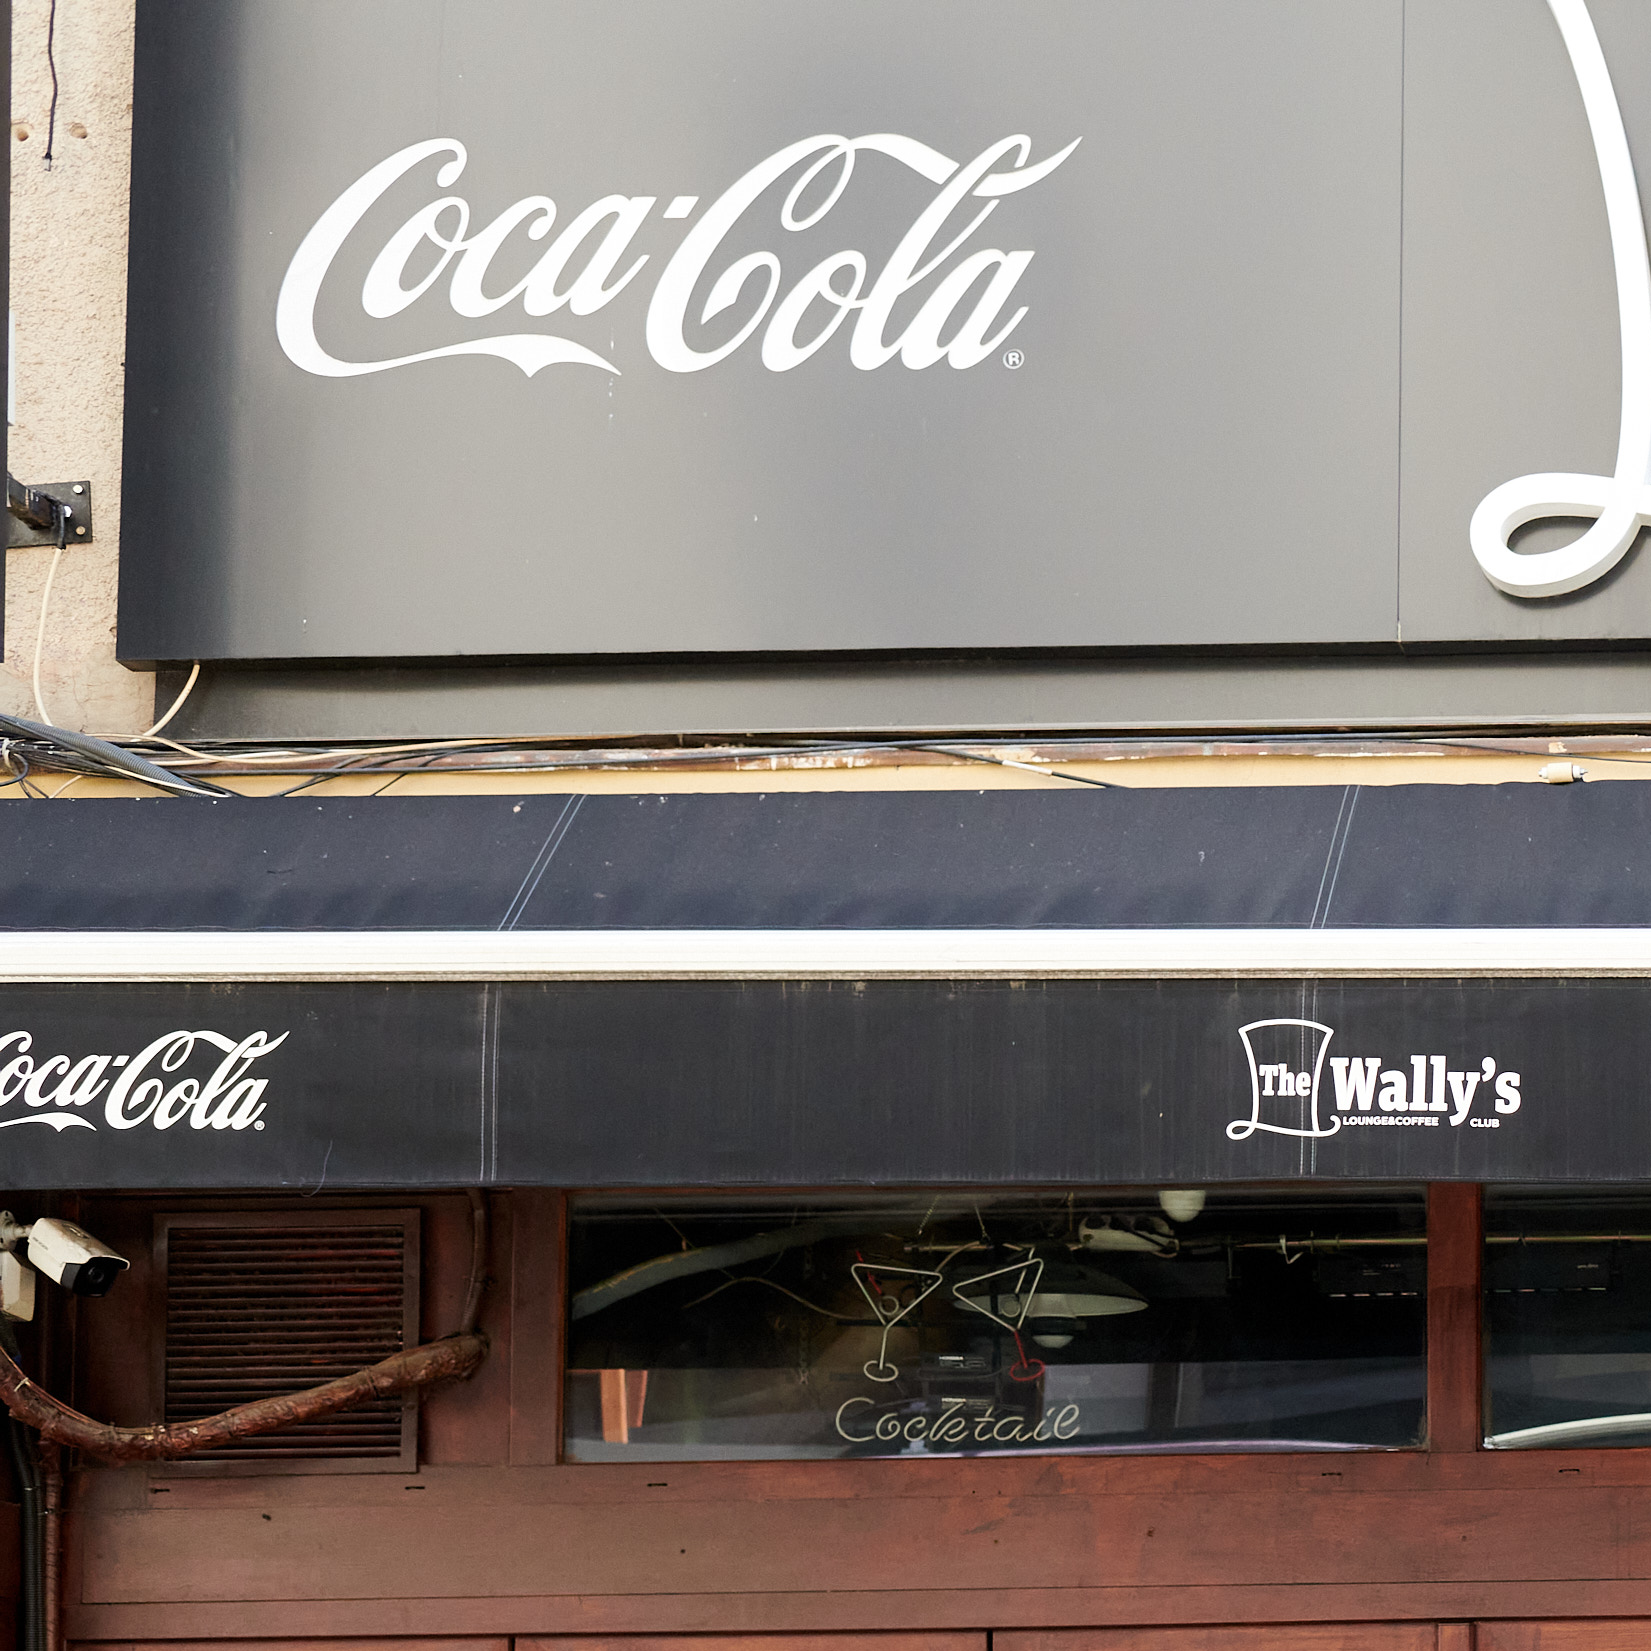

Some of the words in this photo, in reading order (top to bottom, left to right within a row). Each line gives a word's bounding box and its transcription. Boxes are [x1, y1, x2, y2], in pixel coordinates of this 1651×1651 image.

[276, 133, 1082, 379] Coca-Cola
[1259, 1063, 1311, 1097] The
[1330, 1055, 1521, 1126] Wally's
[1342, 1116, 1439, 1126] LOUNGE&COFFEE
[1470, 1117, 1500, 1128] CLUB
[835, 1396, 1082, 1443] Cocktail
